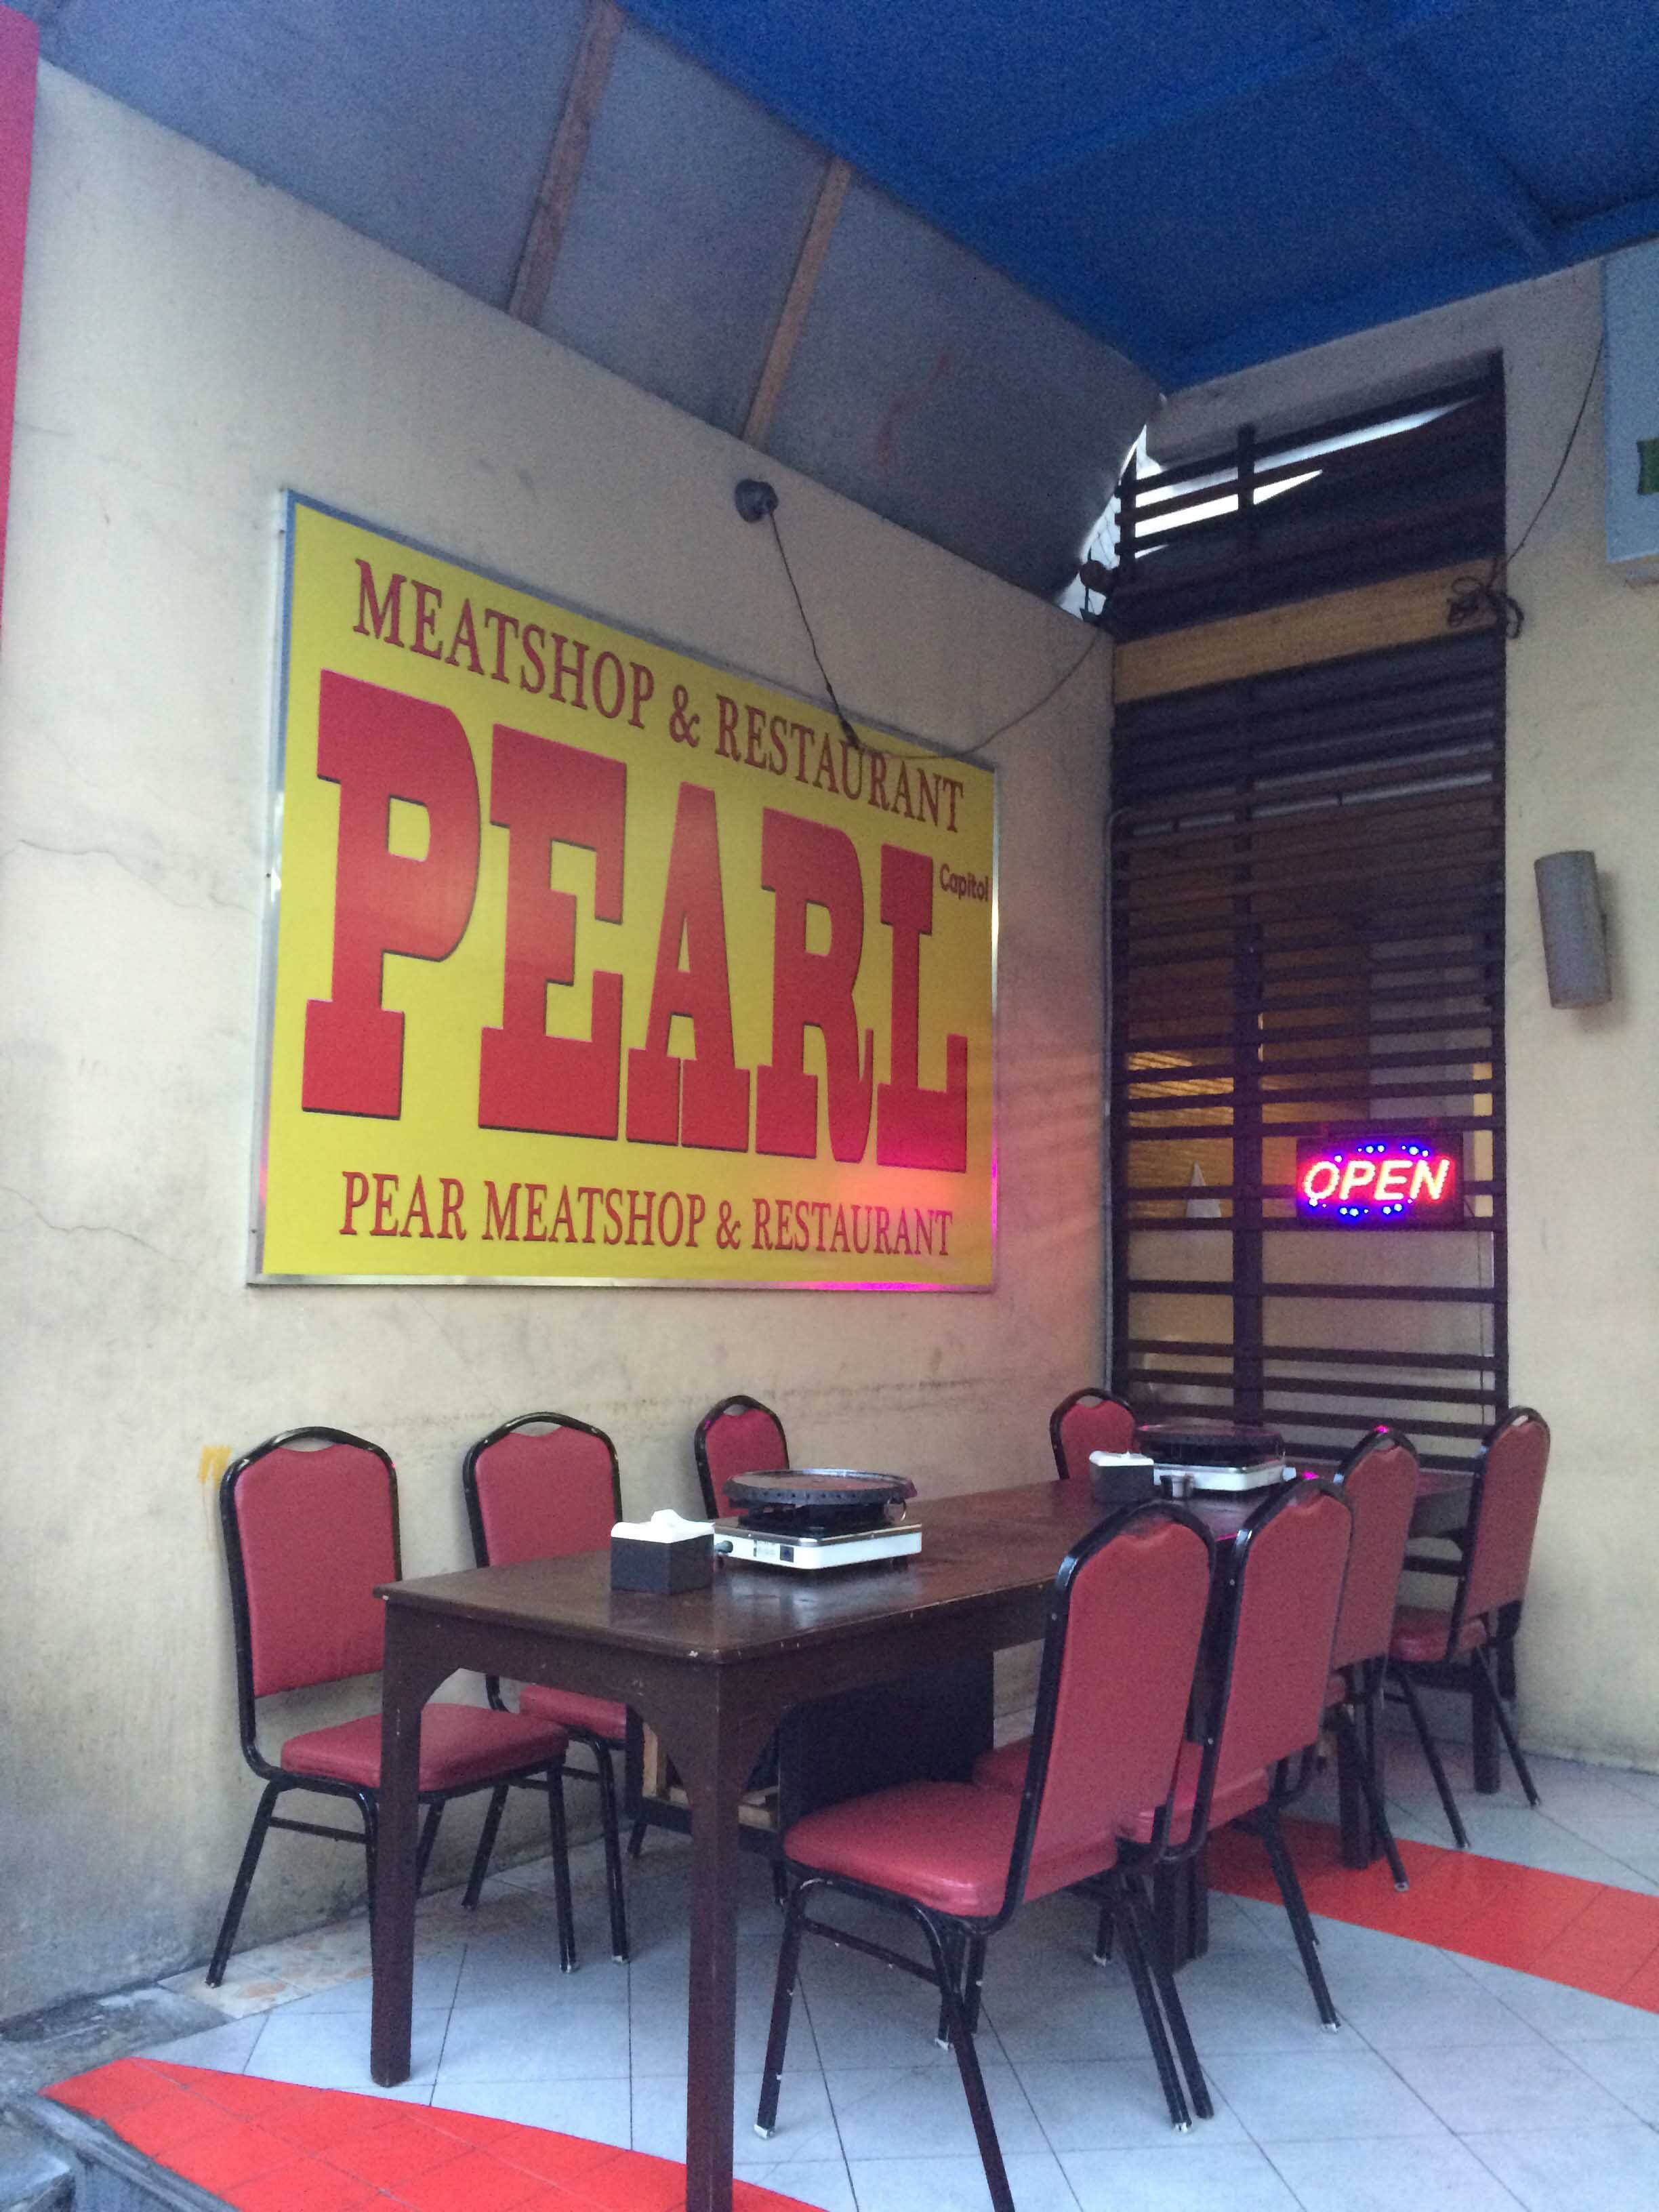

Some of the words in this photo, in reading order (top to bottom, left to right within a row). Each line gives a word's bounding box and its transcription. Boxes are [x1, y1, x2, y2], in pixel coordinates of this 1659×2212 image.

[352, 558, 655, 729] MEATSHOP
[668, 684, 700, 748] &
[715, 693, 964, 833] RESTAURANT
[302, 668, 968, 1173] PEARL
[939, 863, 989, 903] Capitol
[339, 1170, 467, 1241] PEAR
[481, 1180, 706, 1249] MEATSHOP
[716, 1200, 741, 1250] &
[751, 1197, 953, 1256] RESTAURANT
[1303, 1158, 1450, 1201] OPEN
